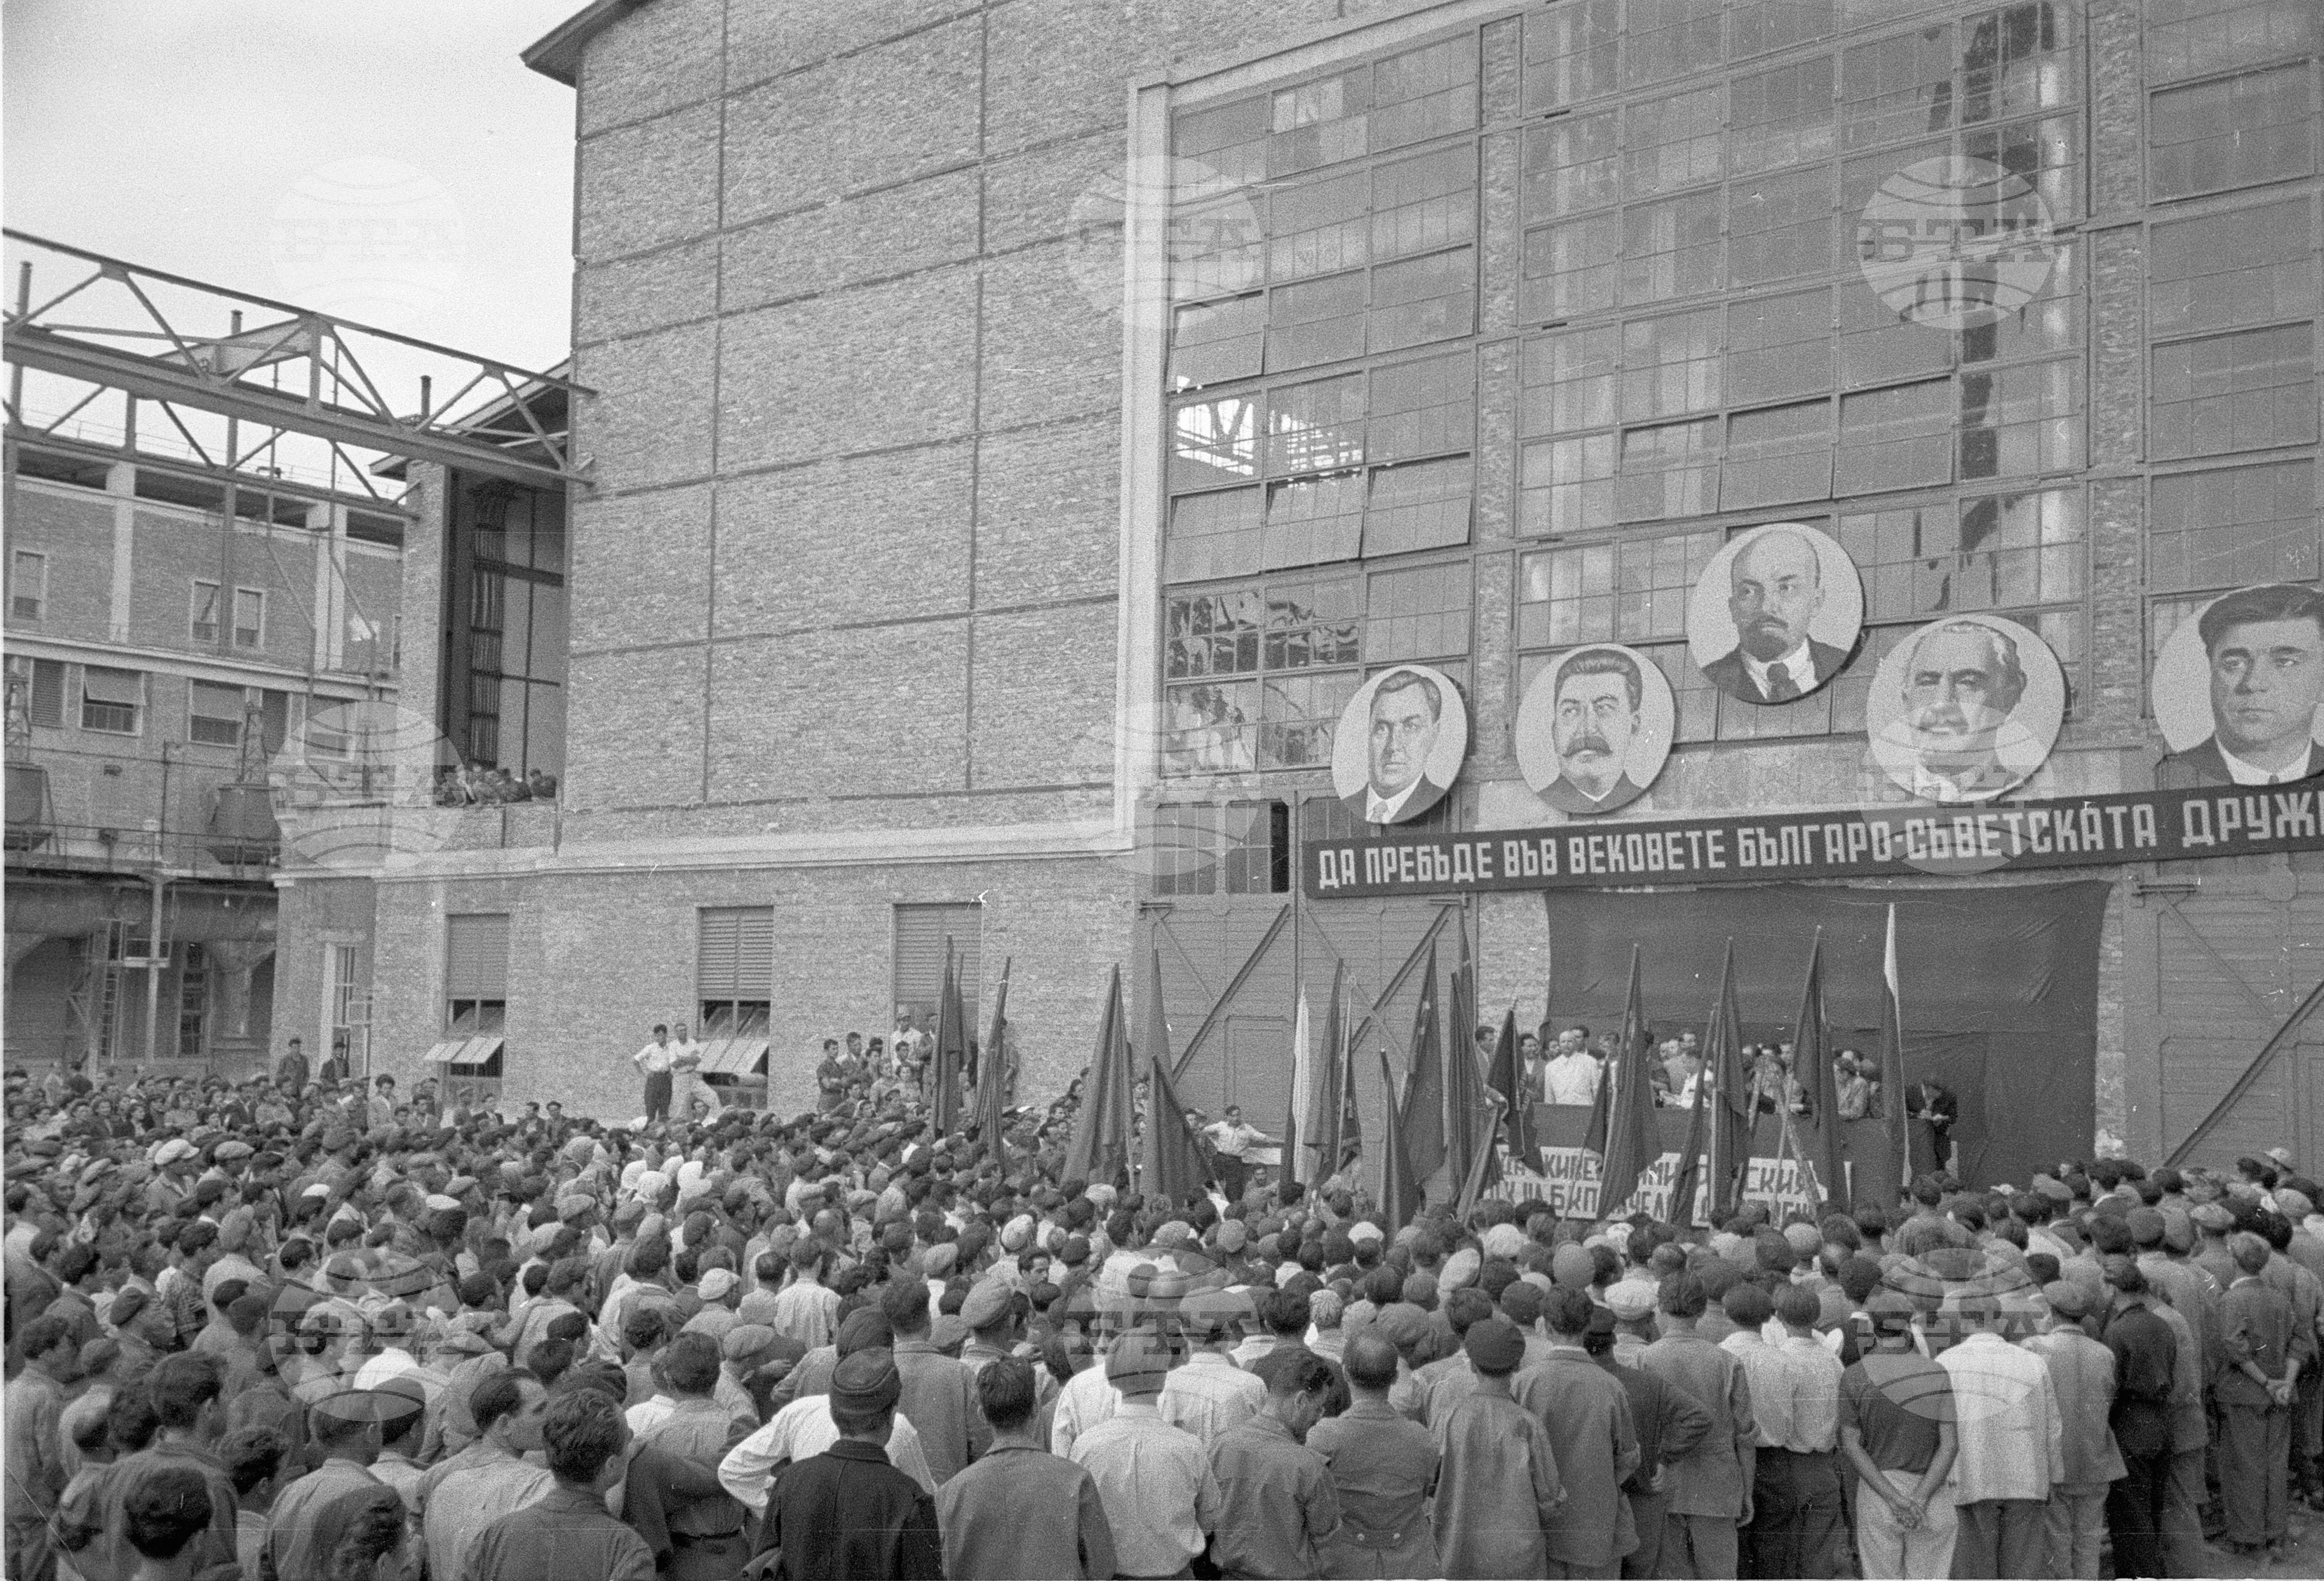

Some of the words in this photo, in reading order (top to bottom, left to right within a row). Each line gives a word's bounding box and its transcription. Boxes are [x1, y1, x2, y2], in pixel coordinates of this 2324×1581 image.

[1319, 849, 1356, 889] ДА
[1365, 842, 1494, 884] ПРЕБЪДЕ
[1503, 838, 1558, 877] ВЪВ
[1569, 829, 1726, 874] ВЕКОВЕТЕ
[1542, 1153, 1598, 1181] ЖИВЕ
[1550, 1183, 1598, 1214] БКП
